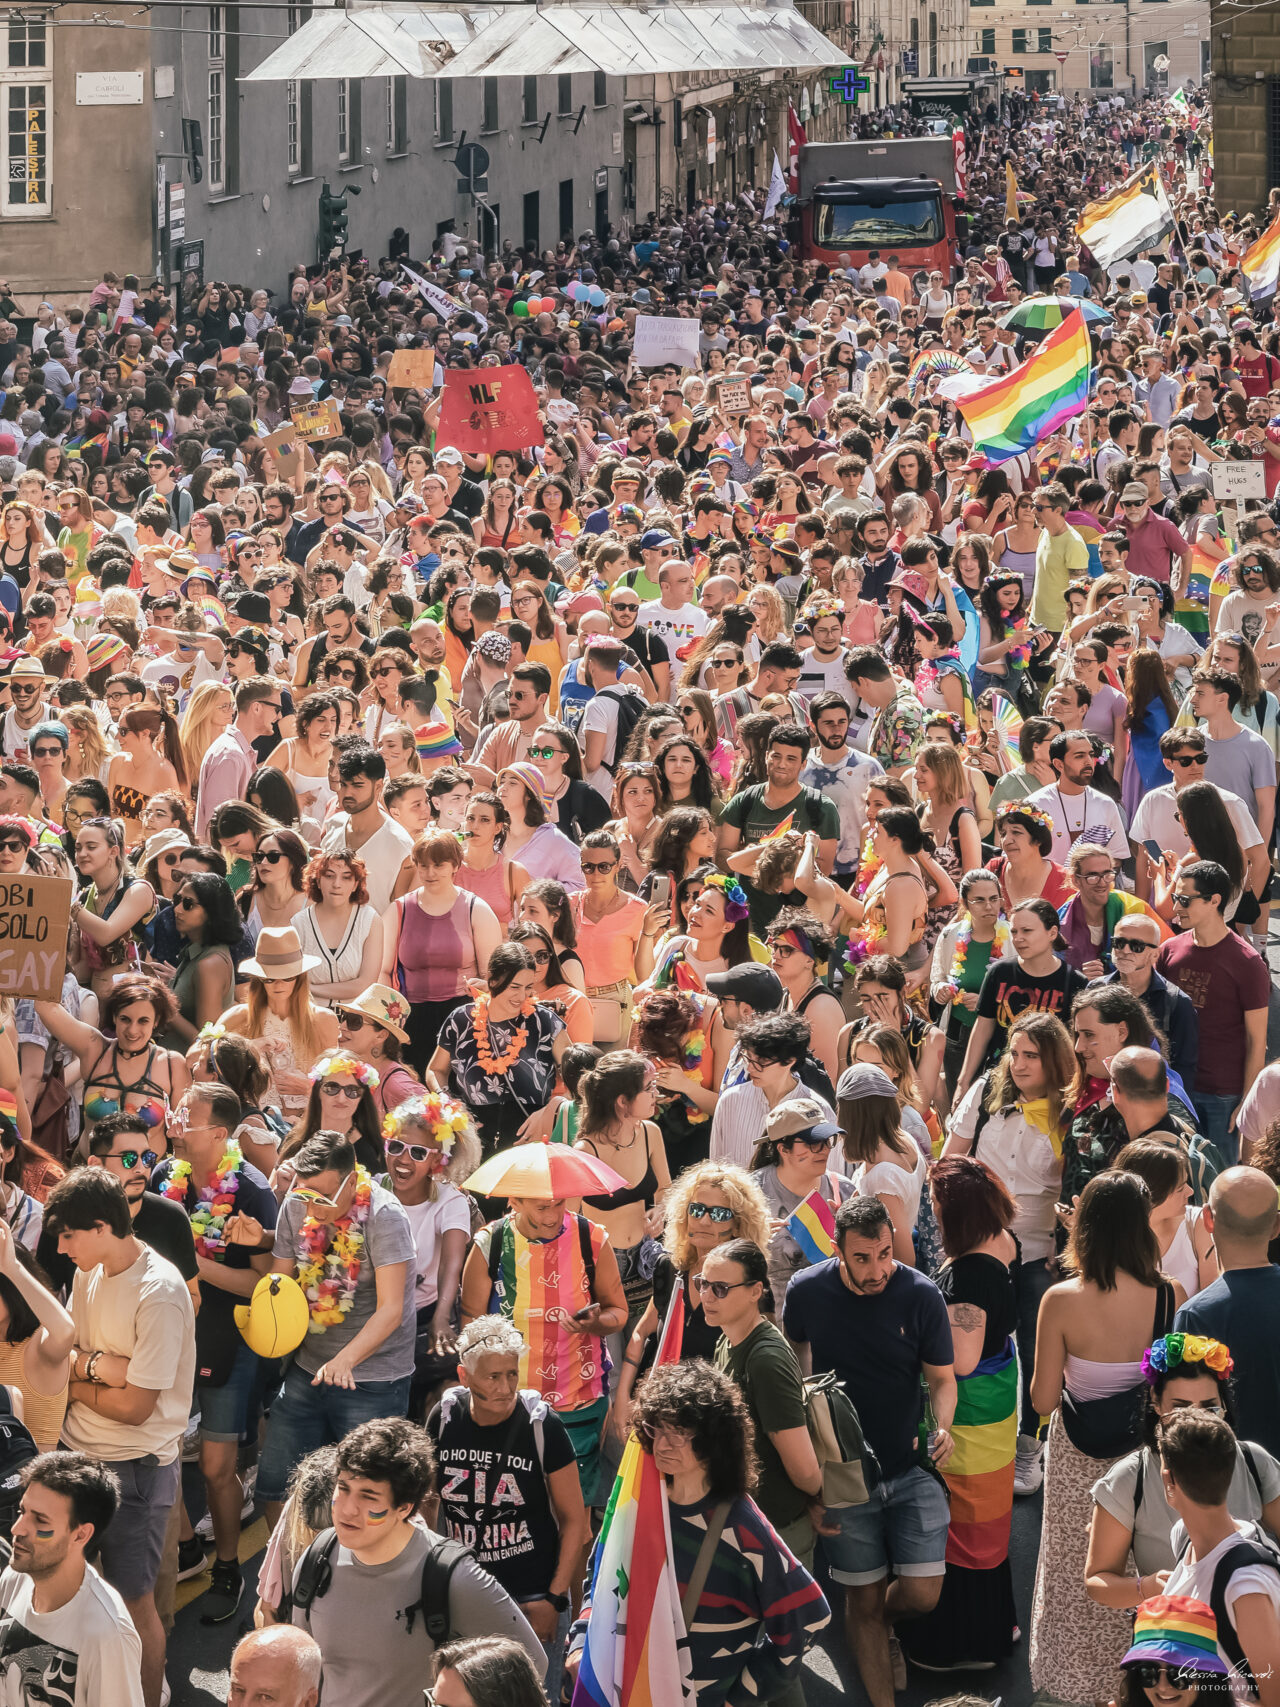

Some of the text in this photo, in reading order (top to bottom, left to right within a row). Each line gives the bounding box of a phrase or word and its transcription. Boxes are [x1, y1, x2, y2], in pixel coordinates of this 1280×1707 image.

[28, 110, 40, 203] PALESTRA
[1226, 465, 1247, 474] FREE
[1228, 477, 1247, 485] HUGS
[451, 1449, 467, 1461] HO
[469, 1449, 492, 1463] DUE
[496, 1453, 533, 1472] TTOLI
[441, 1466, 526, 1507] ZIA
[493, 1550, 500, 1560] IN
[501, 1540, 535, 1559] ENTRAMBI
